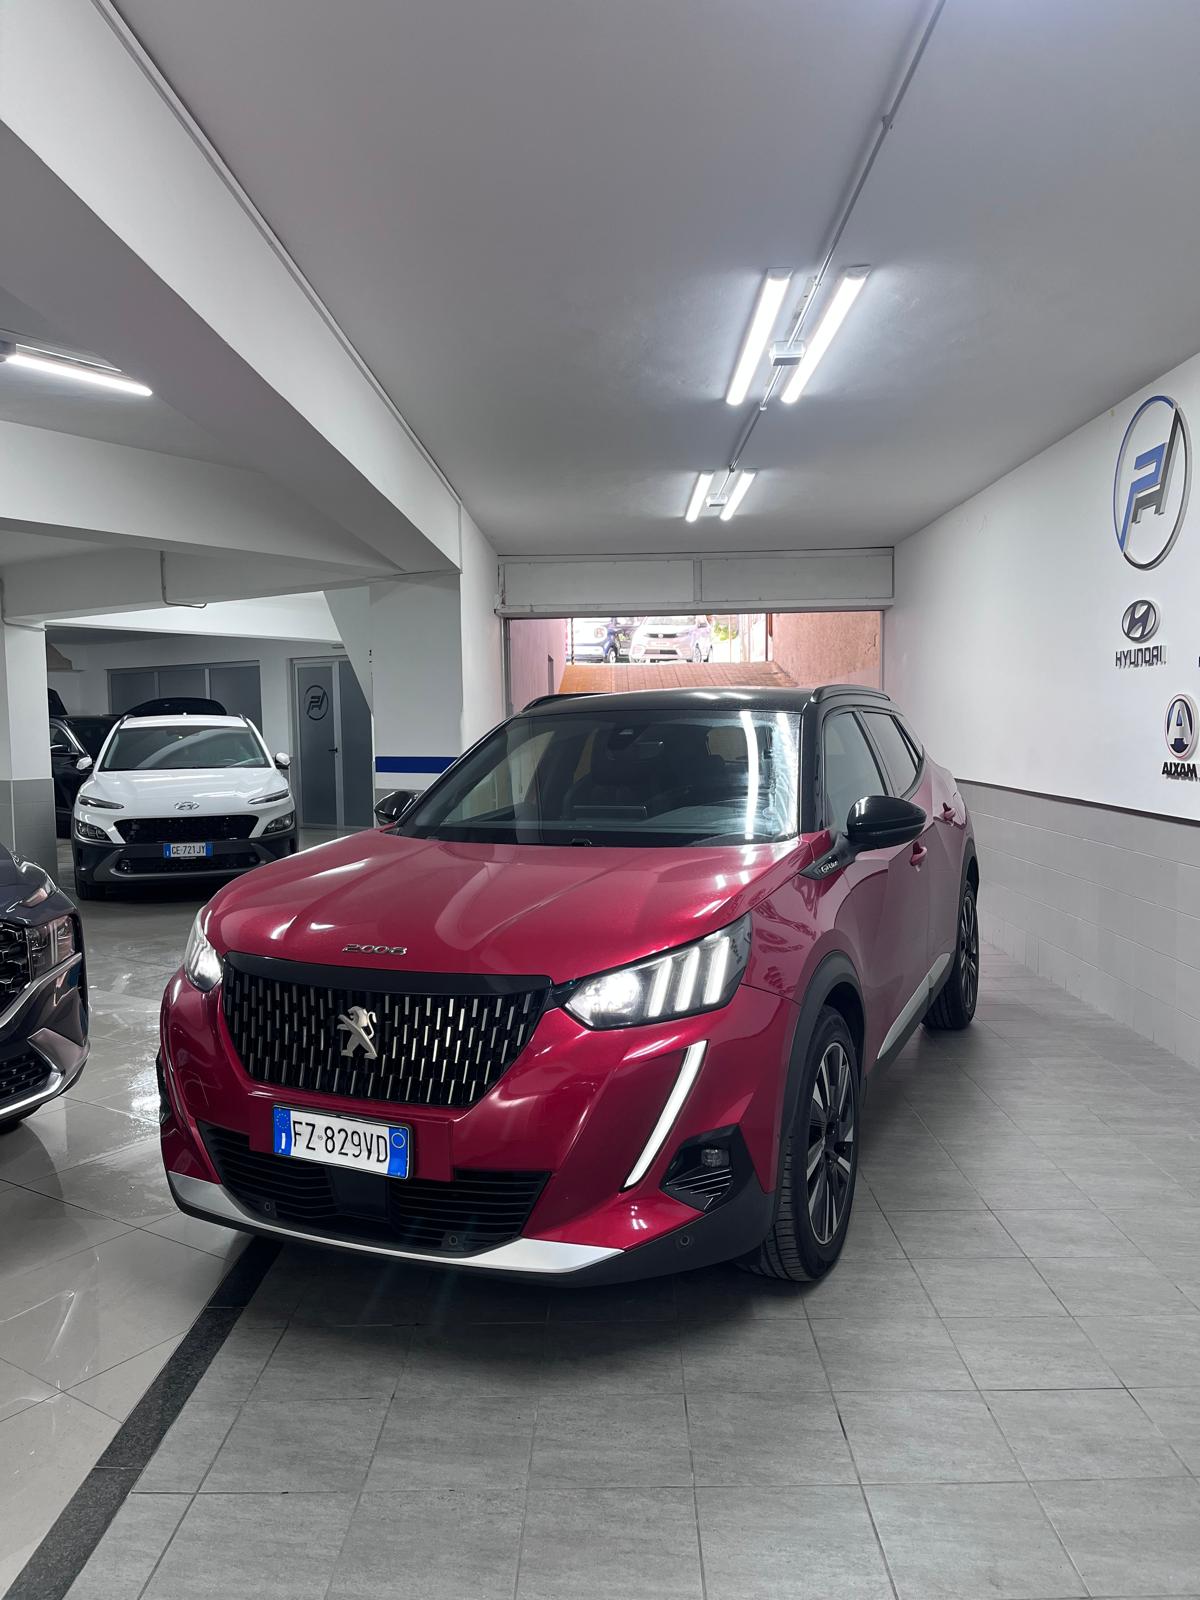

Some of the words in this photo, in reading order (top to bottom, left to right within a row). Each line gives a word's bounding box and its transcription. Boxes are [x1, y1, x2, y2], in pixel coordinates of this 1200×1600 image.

[1115, 645, 1163, 667] HYUNDAI
[1161, 761, 1198, 777] AIXAM
[342, 943, 408, 955] 2008
